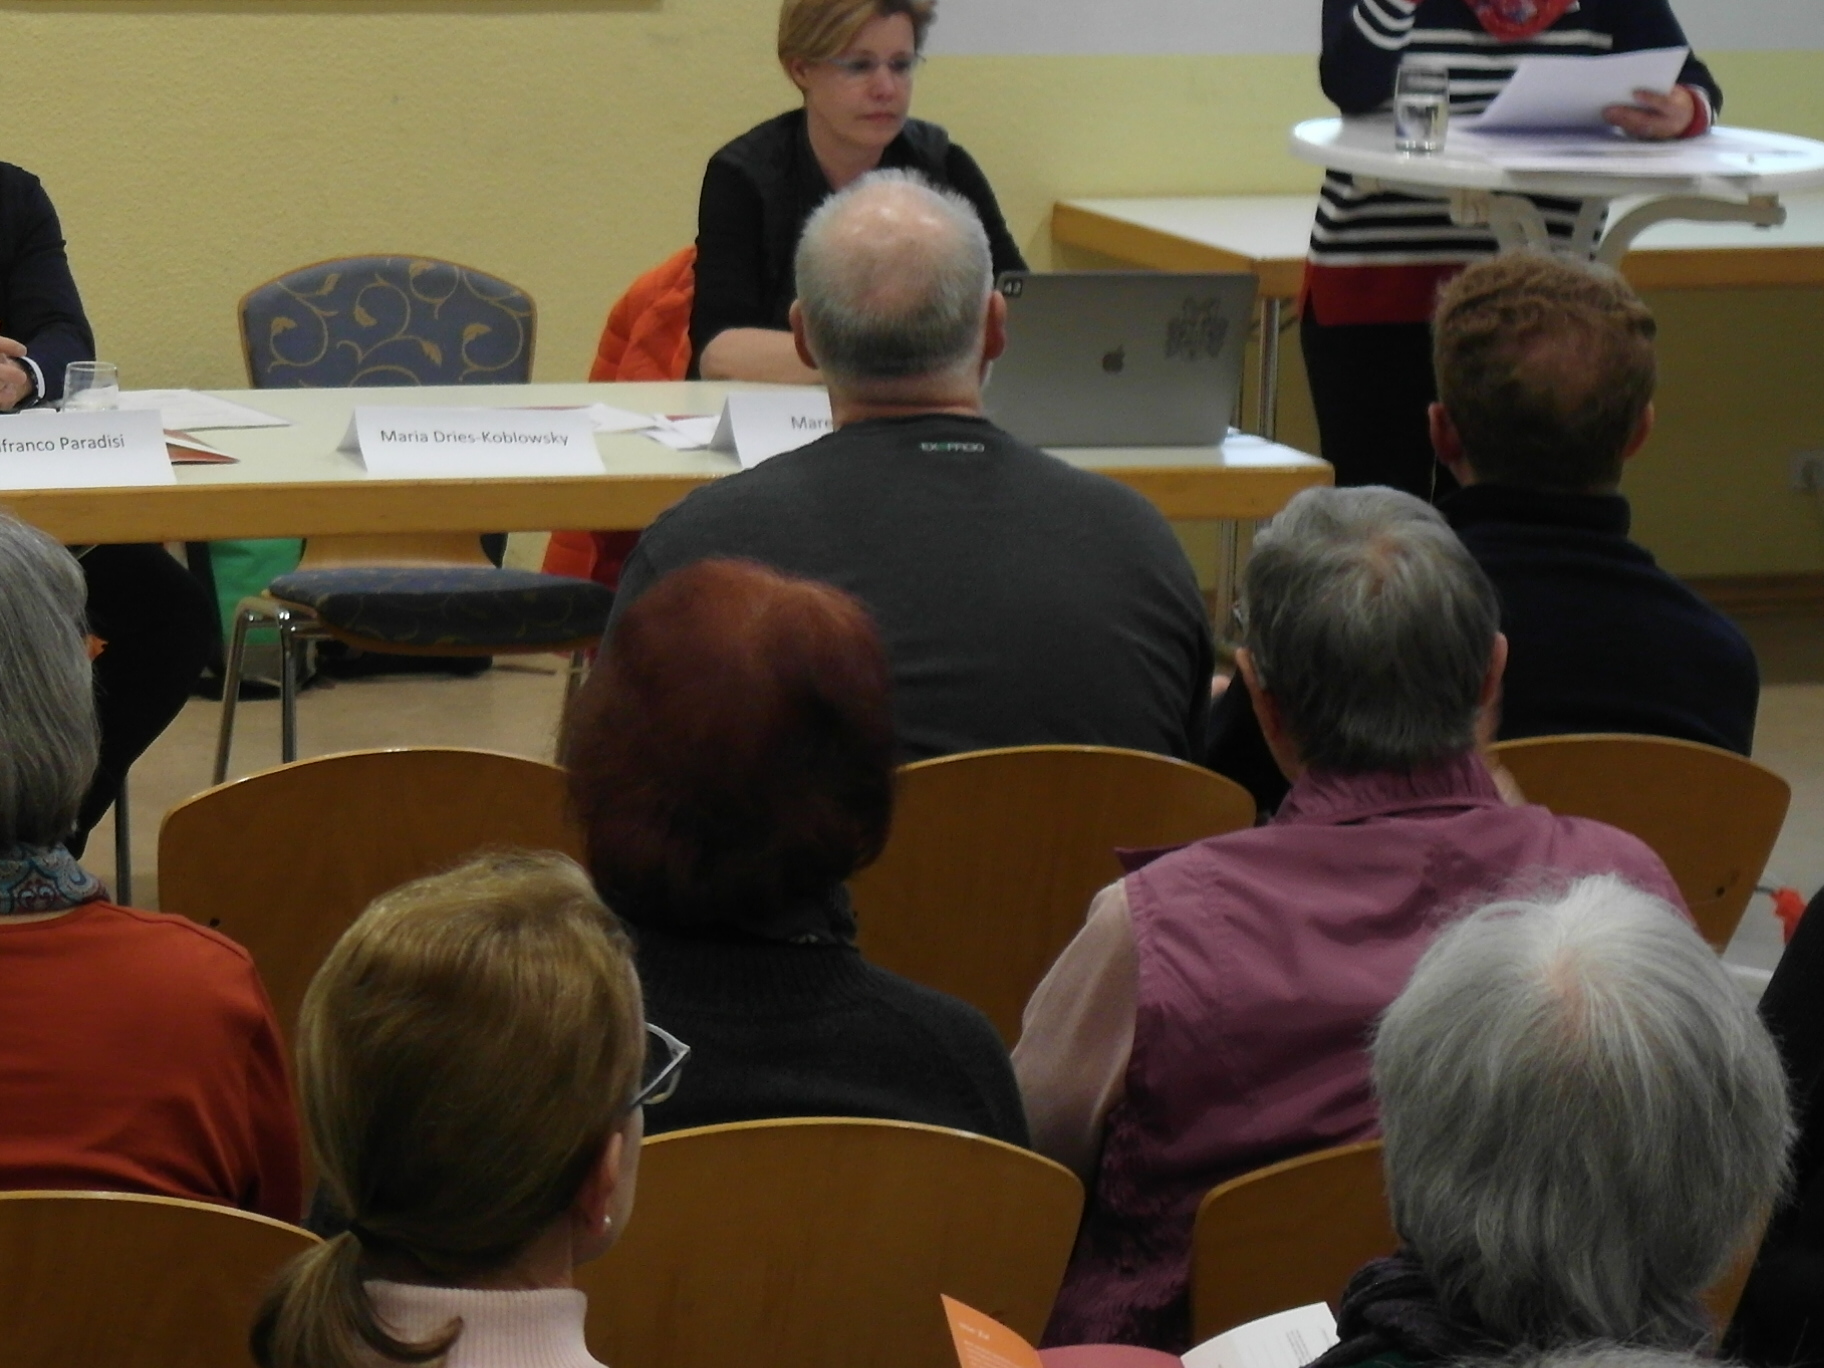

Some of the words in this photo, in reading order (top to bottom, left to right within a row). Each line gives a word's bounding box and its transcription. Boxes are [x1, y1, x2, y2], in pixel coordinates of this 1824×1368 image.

[59, 433, 126, 451] Paradisi
[380, 429, 429, 443] Maria
[433, 430, 569, 447] Dries-Koblowsky
